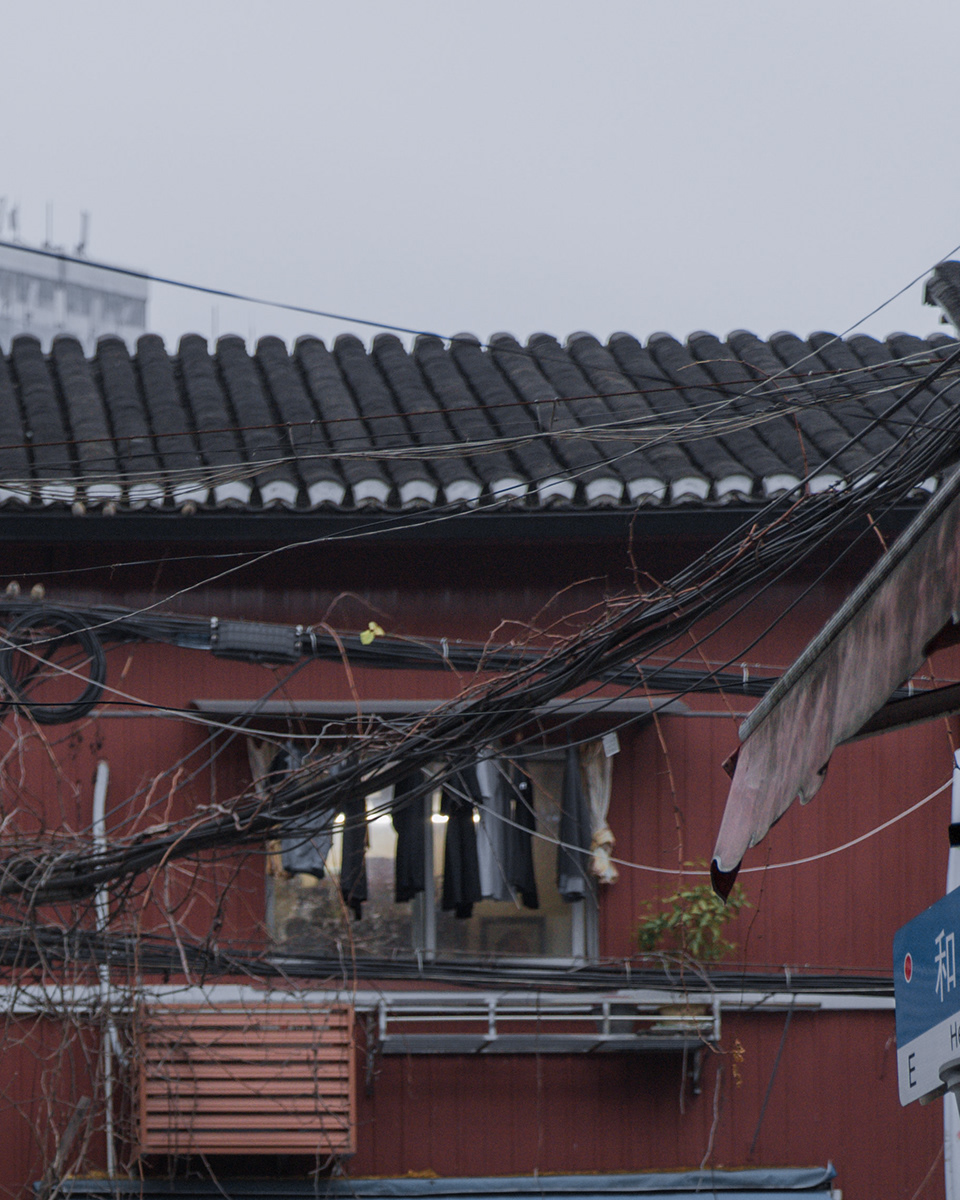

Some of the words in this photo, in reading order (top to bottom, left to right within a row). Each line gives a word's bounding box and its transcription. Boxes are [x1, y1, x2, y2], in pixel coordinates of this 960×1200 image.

[935, 928, 957, 1003] 和
[950, 1021, 960, 1051] H
[908, 1052, 917, 1088] E
